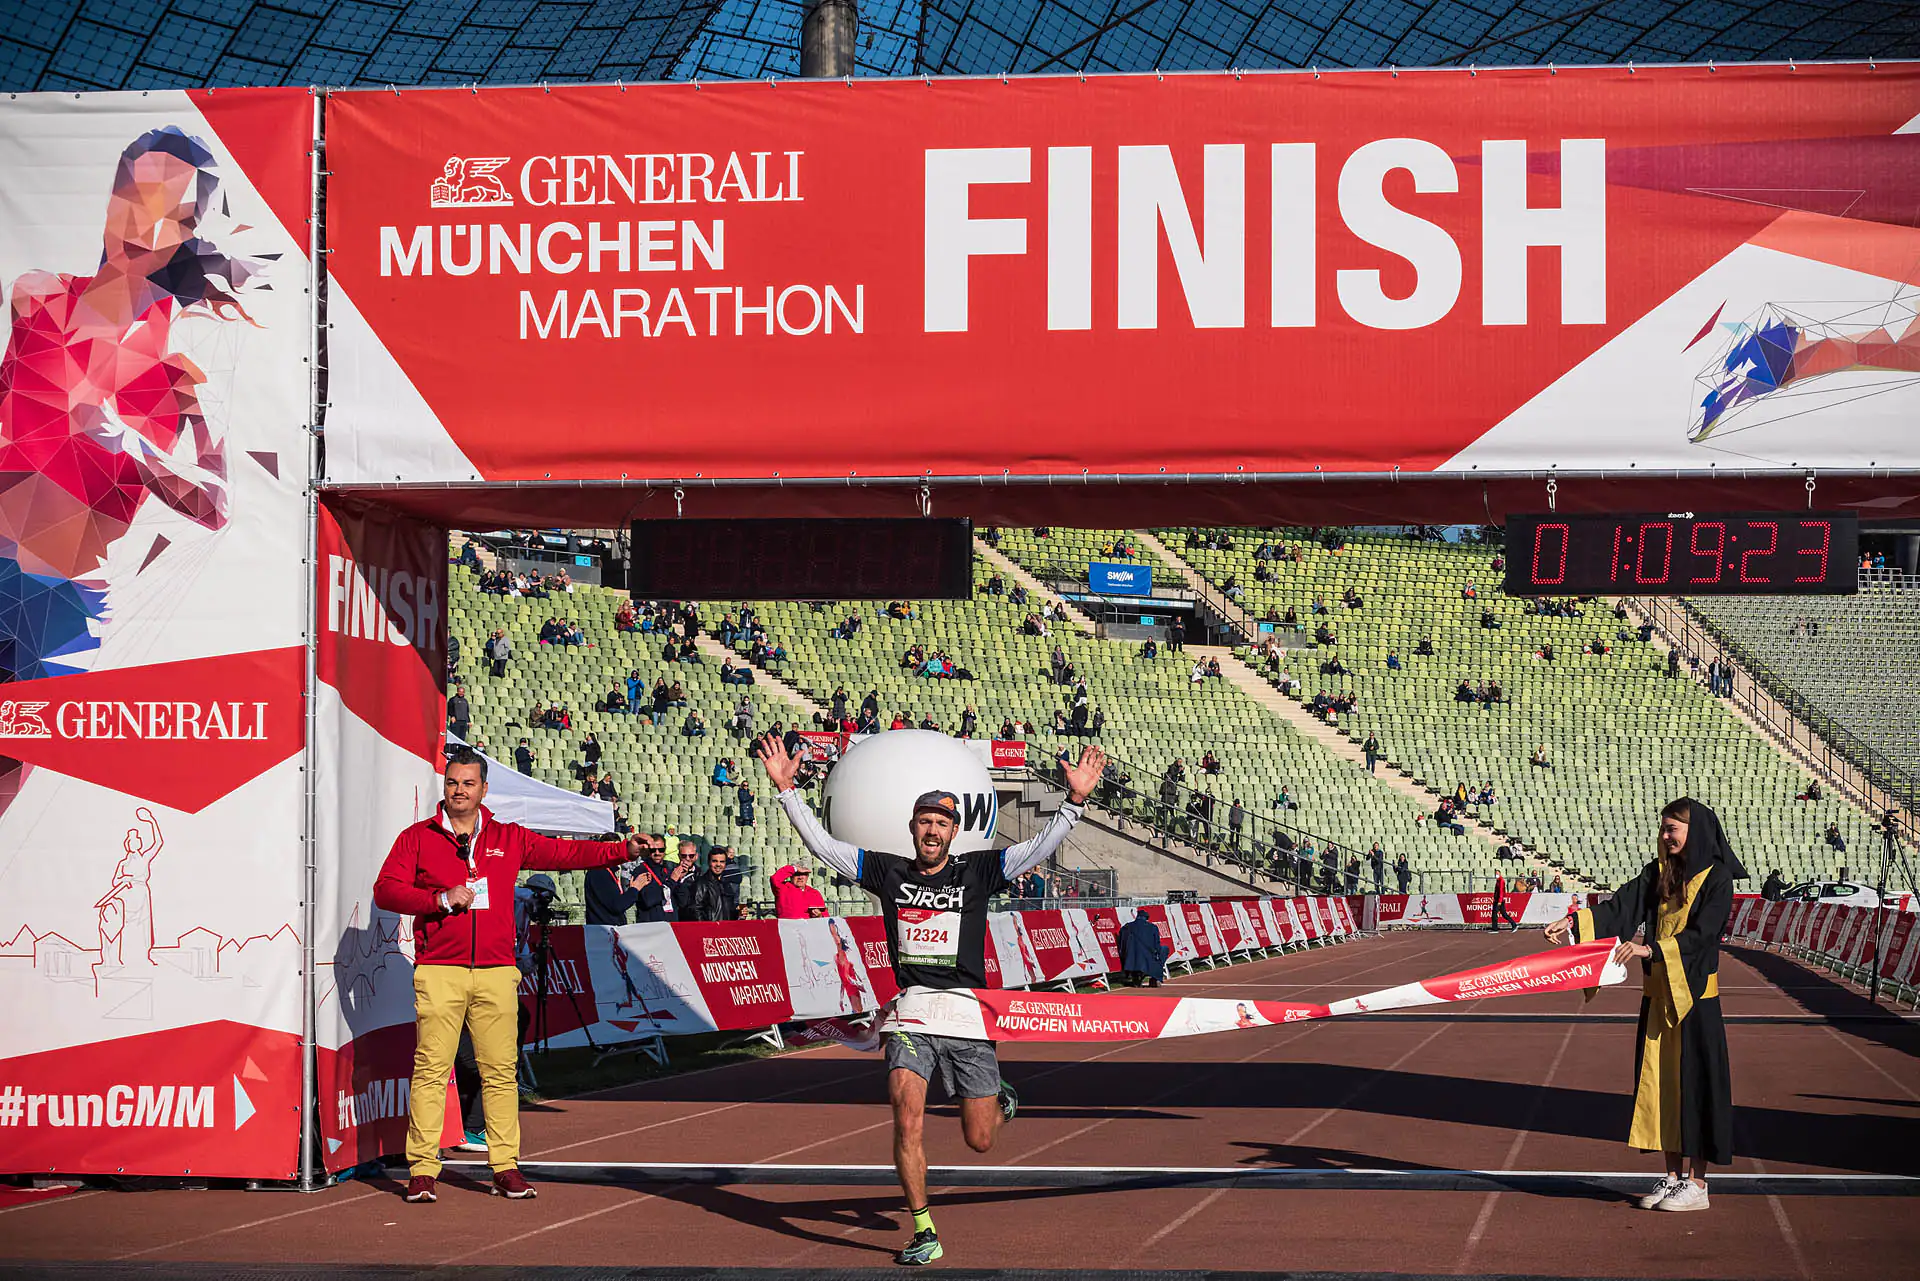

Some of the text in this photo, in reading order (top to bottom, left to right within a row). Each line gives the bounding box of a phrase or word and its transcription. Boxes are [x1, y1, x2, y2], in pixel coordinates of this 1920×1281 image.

[520, 151, 805, 206] GENERALI
[924, 137, 1606, 333] FINISH
[379, 219, 724, 277] MÜNCHEN
[519, 284, 864, 340] MARATHON
[328, 554, 439, 651] FINISH
[56, 700, 269, 740] GENERALI
[1005, 748, 1025, 757] GENE
[895, 883, 964, 909] SIRCH
[1379, 902, 1401, 912] ERALI
[715, 936, 761, 957] GENERALI
[905, 927, 948, 943] 12324
[700, 960, 758, 982] MÜNCHEN
[1474, 966, 1530, 988] GENERALI
[1525, 964, 1593, 988] MARATHON
[729, 984, 785, 1006] MARATHON
[1026, 1001, 1082, 1017] GENERALI
[996, 1015, 1150, 1034] MÜNCHEN MARATHON
[0, 1085, 215, 1127] #runGMM
